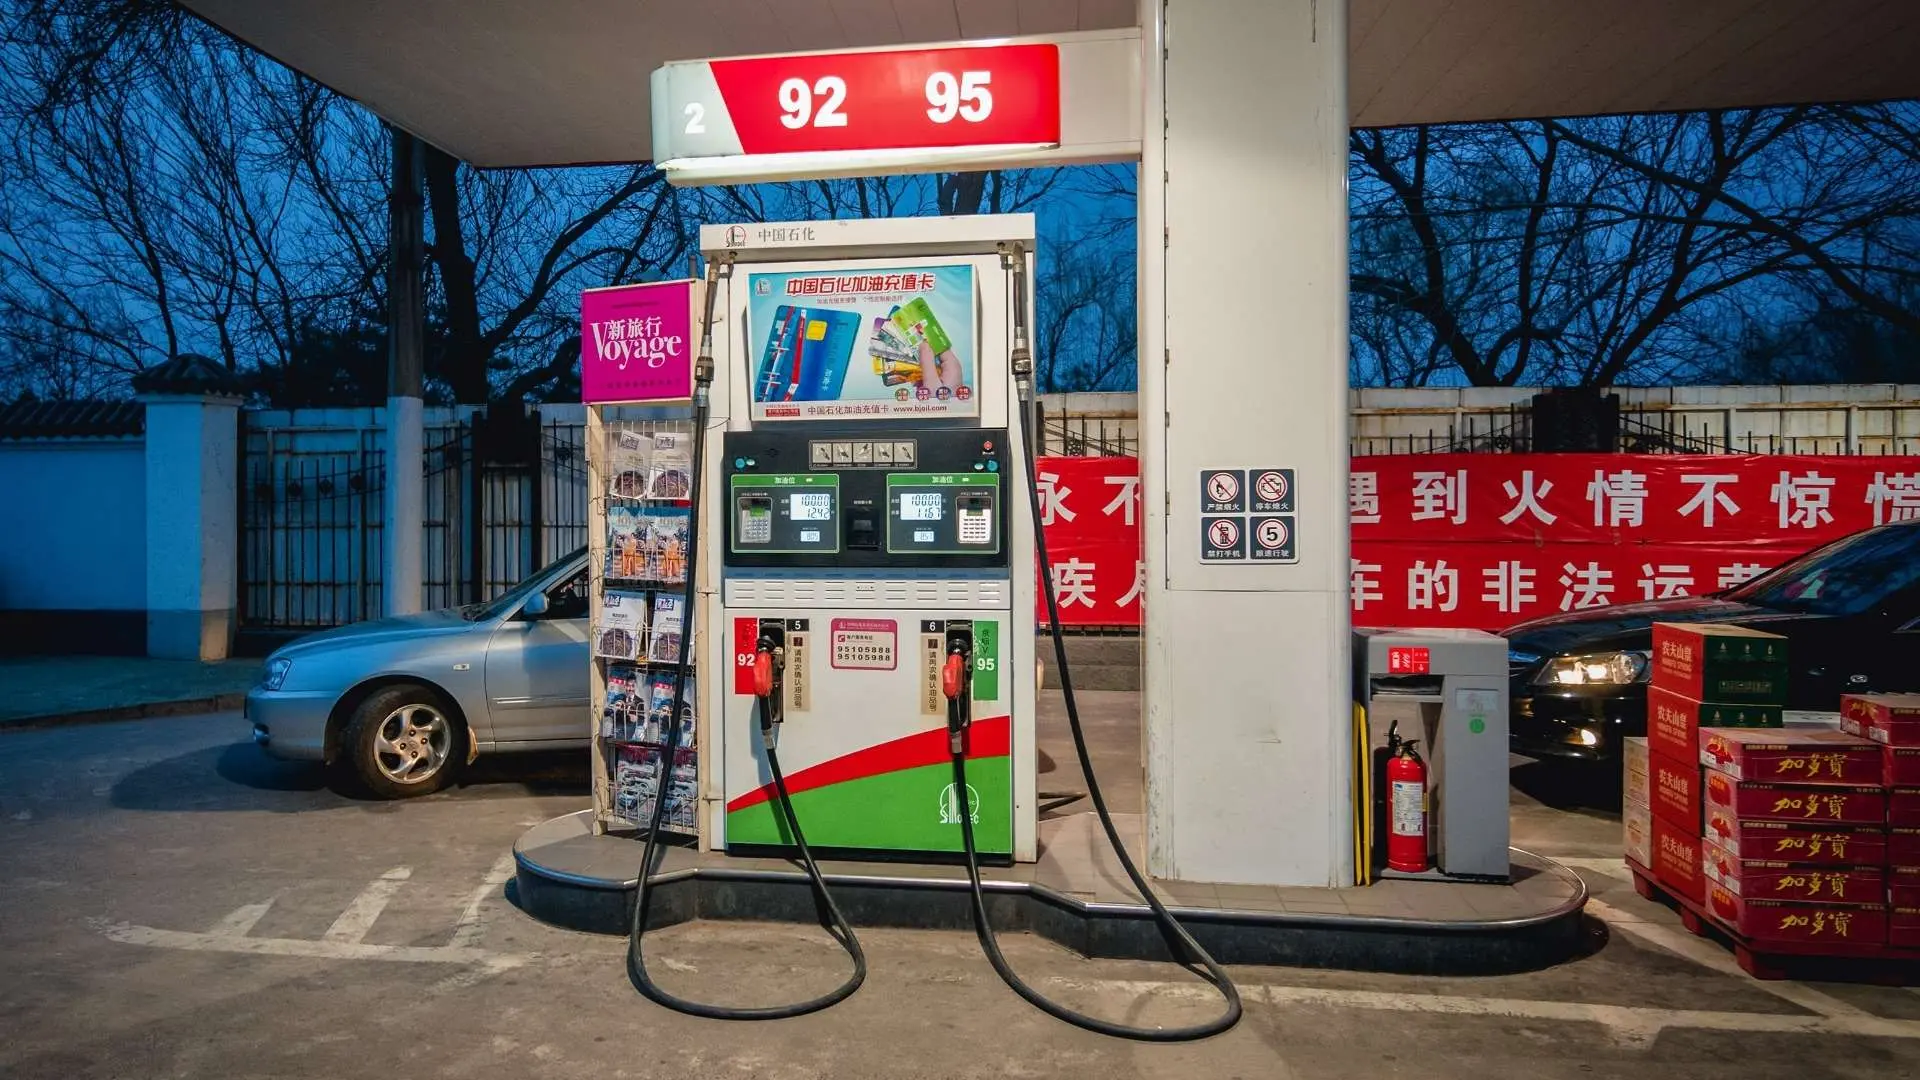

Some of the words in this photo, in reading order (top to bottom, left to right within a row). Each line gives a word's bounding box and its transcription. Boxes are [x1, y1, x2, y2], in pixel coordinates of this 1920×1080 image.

[778, 76, 848, 129] 92
[925, 70, 993, 124] 95
[684, 102, 705, 134] 2
[758, 227, 815, 242] 中国石化
[787, 273, 934, 295] 中国石化加油充值卡
[608, 316, 662, 340] 新旅行
[590, 322, 682, 370] Voyage
[807, 404, 889, 416] 中国石化加油充值卡
[893, 404, 947, 413] www.bjoil.com
[1206, 503, 1240, 511] 严禁烟火
[1255, 502, 1289, 510] 停车熄火
[1266, 527, 1279, 542] 5
[1207, 550, 1241, 558] 禁打手机
[1255, 549, 1290, 558] 限速行驶
[794, 620, 801, 630] 5
[929, 621, 936, 632] 6
[837, 645, 891, 654] 95105888
[737, 653, 756, 667] 92
[837, 653, 891, 661] 95105988
[976, 658, 995, 671] 95
